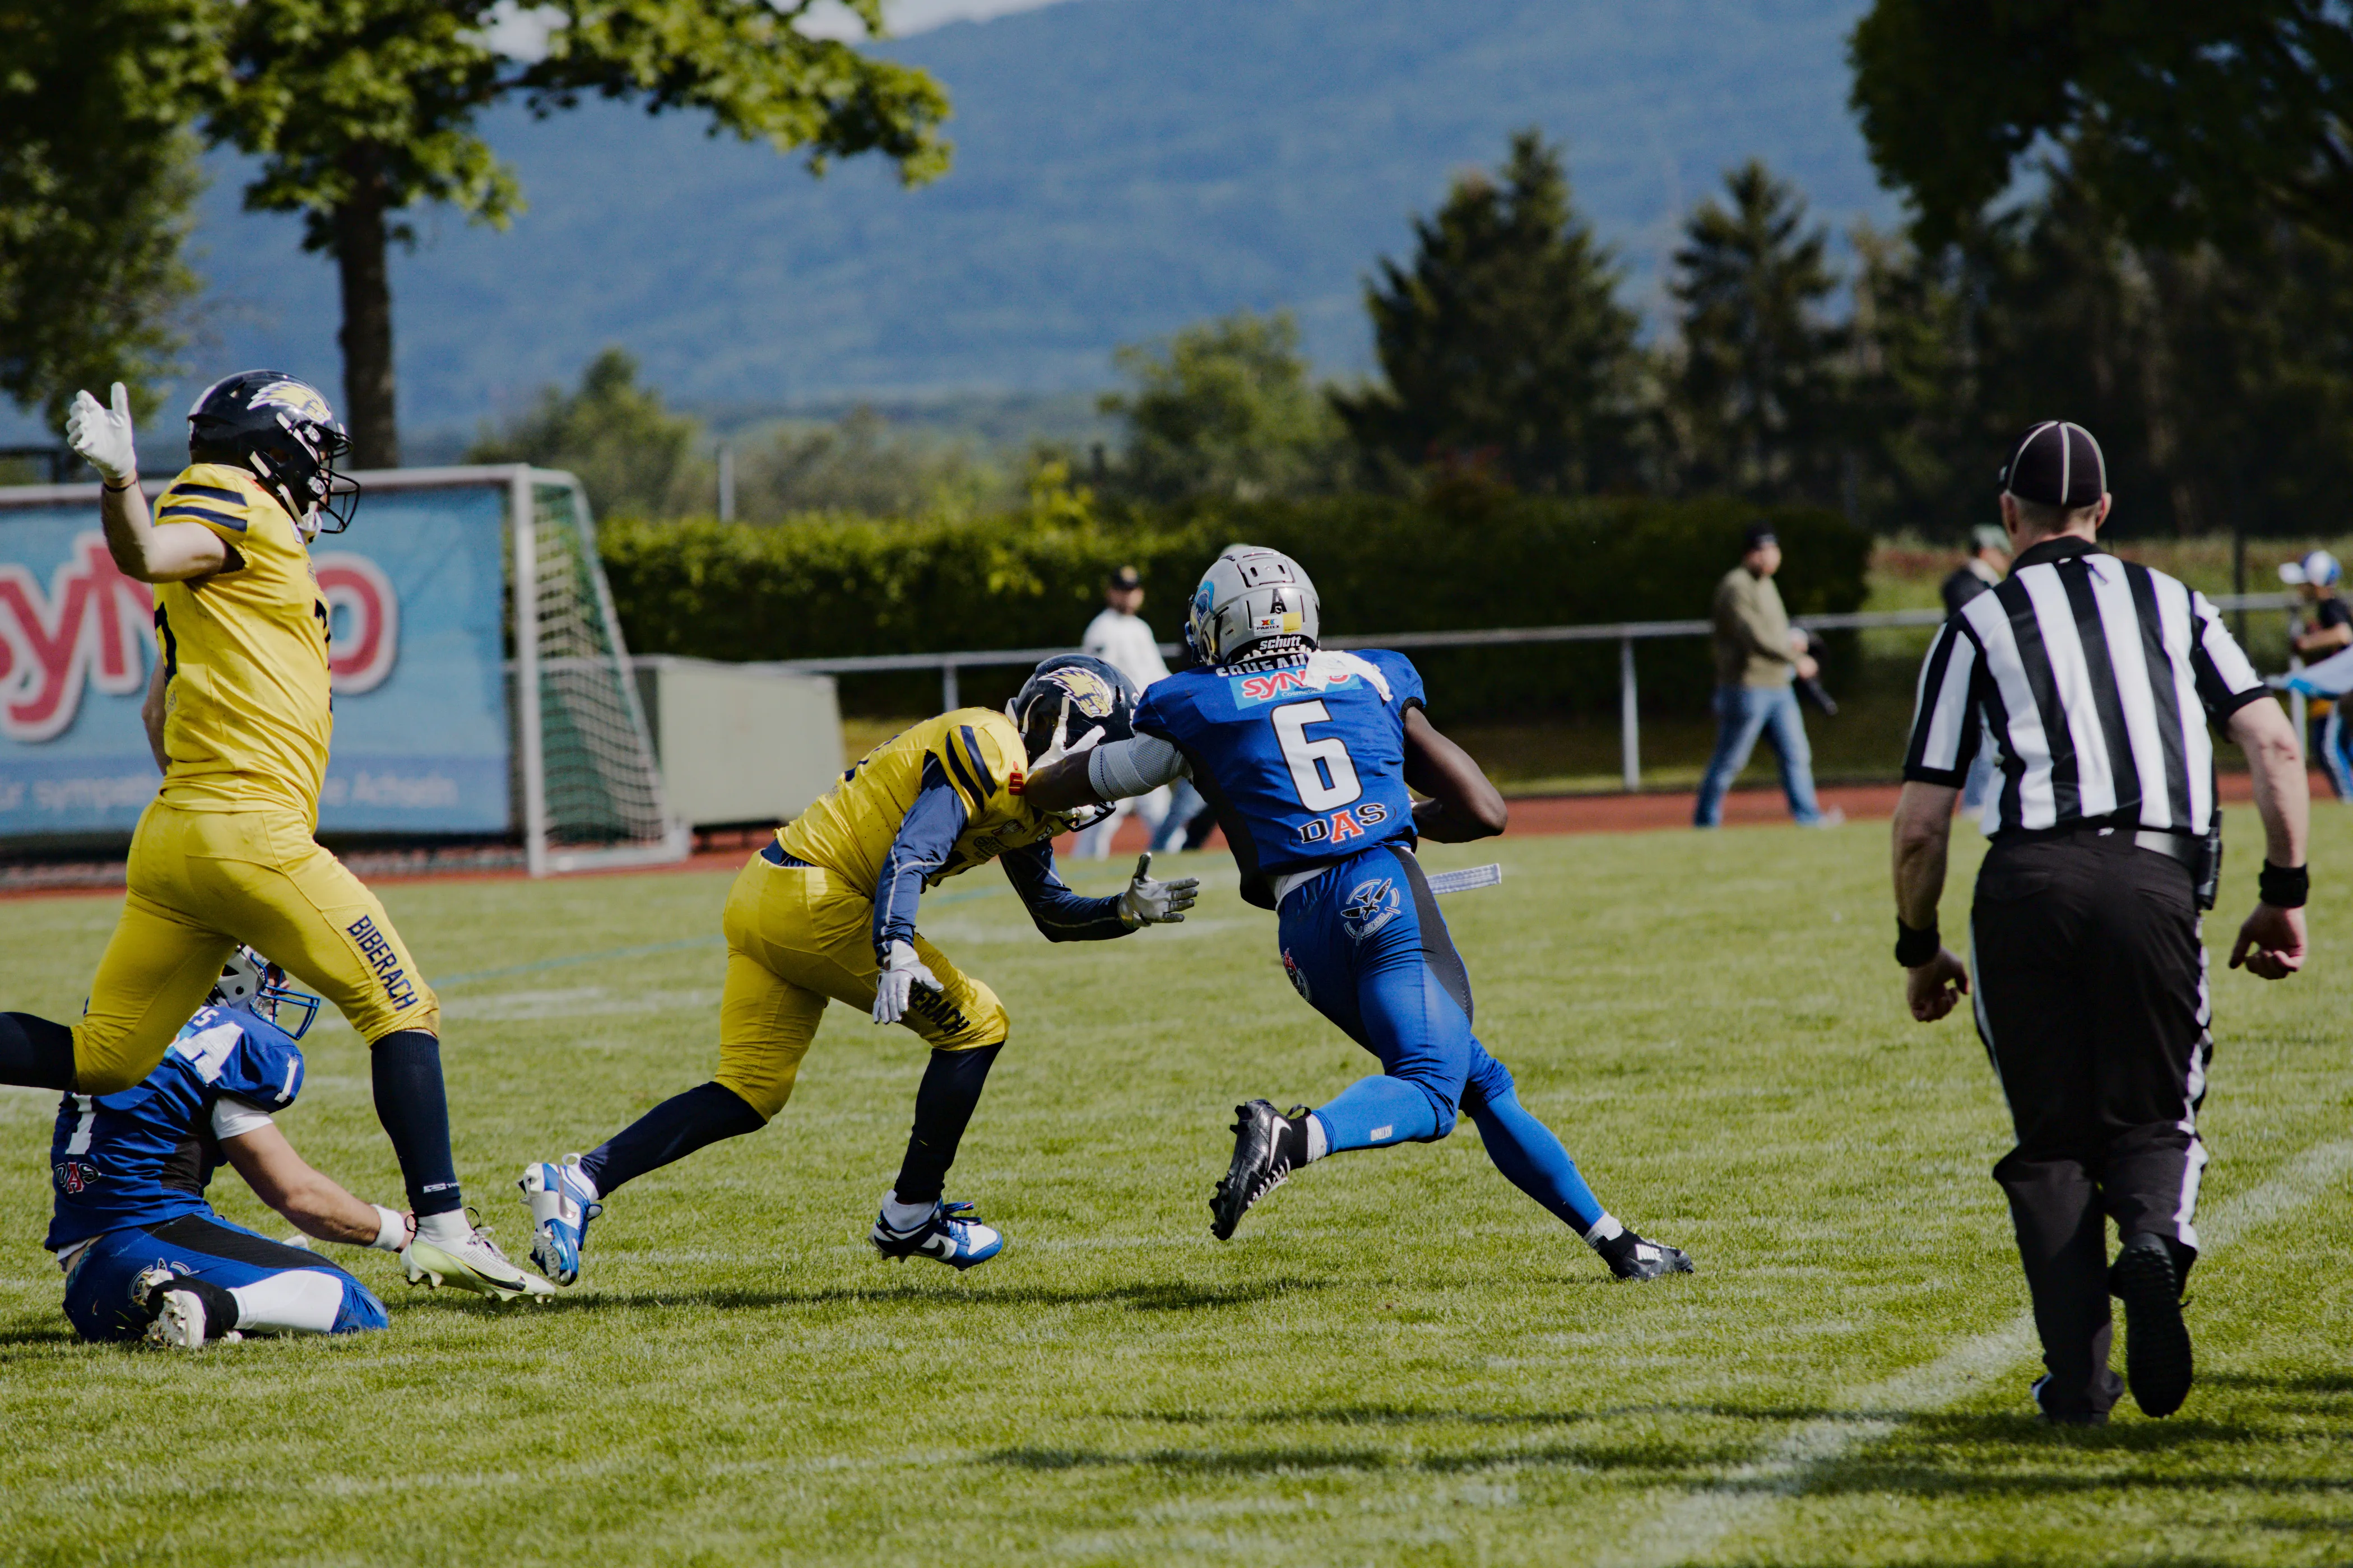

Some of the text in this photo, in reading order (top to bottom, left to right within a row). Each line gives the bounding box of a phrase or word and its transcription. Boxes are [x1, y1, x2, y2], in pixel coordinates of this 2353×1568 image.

[1259, 635, 1302, 650] schutt
[1270, 697, 1363, 813] 6
[1297, 803, 1388, 844] DAS
[345, 914, 419, 1012] BIBERACH
[274, 1055, 299, 1103] 1
[55, 1161, 100, 1194] DAS
[1635, 1243, 1664, 1263] NIKE
